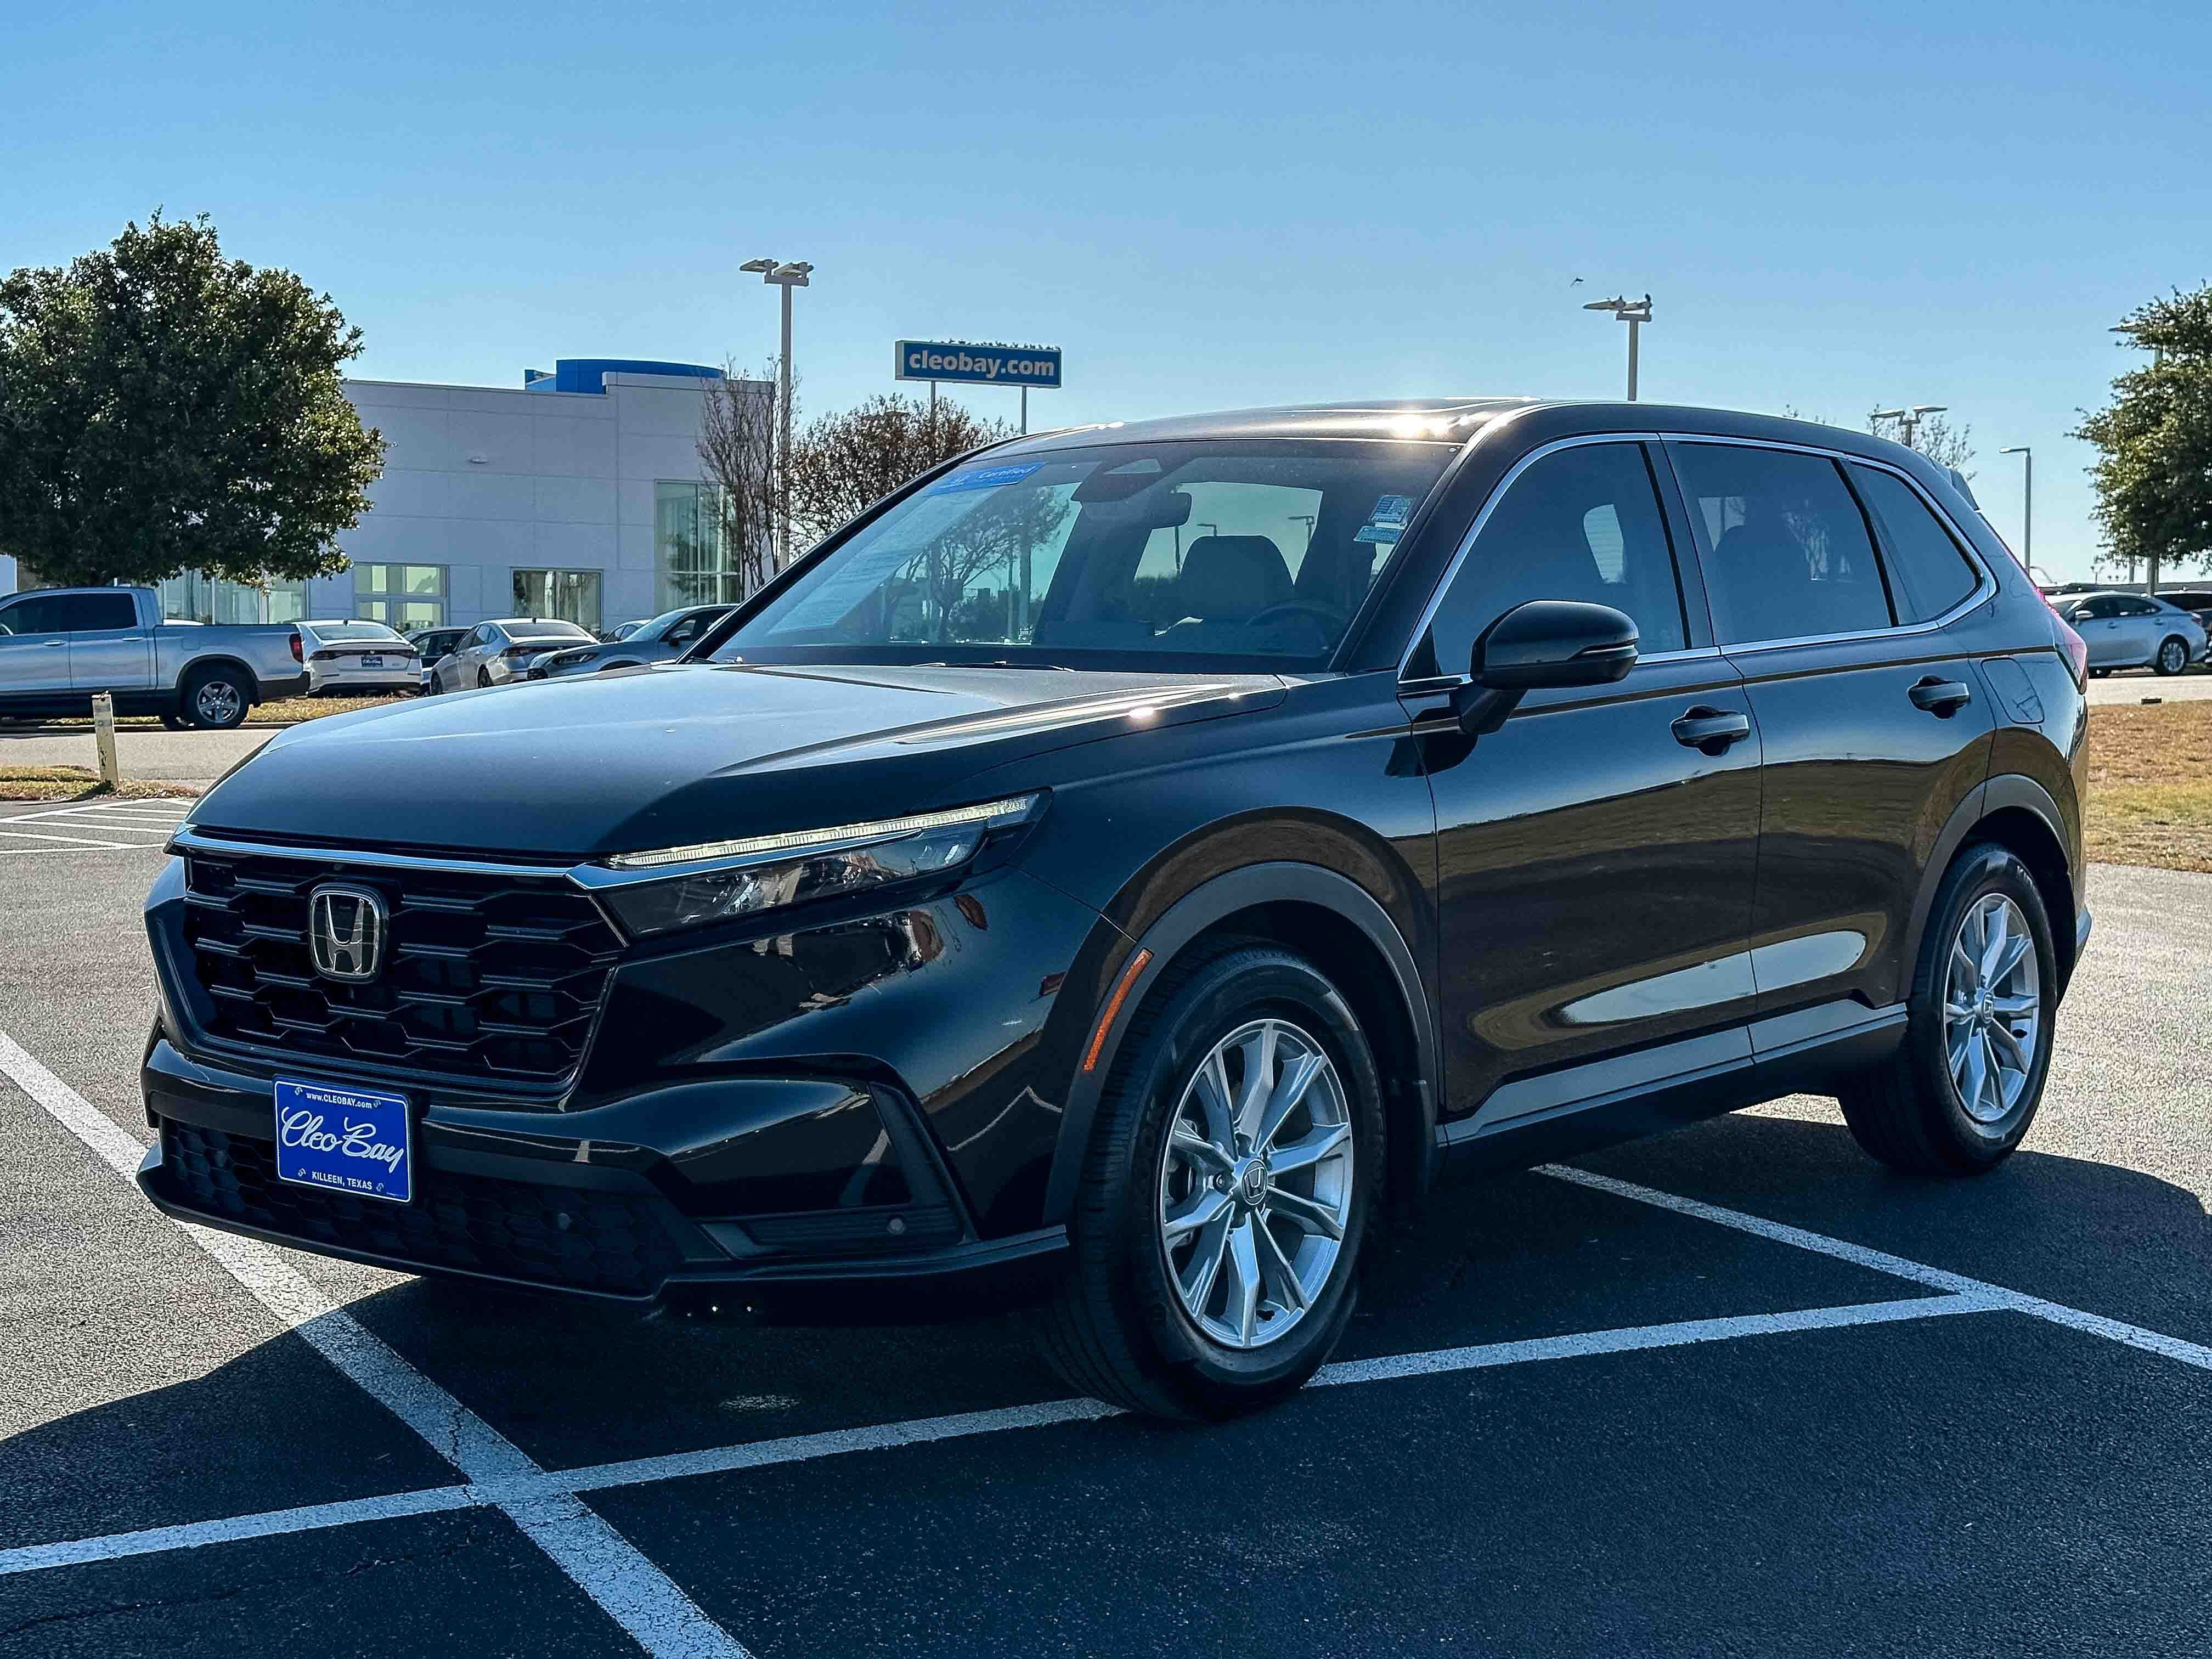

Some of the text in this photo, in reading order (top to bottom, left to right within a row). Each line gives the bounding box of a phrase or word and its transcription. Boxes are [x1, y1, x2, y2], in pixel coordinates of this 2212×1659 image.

[909, 350, 1054, 379] cleobay.com
[306, 1092, 373, 1109] www.CLEOBAY.com
[281, 1106, 404, 1173] Cleo Bay
[312, 1171, 373, 1190] KILLEEN, TEXAS
